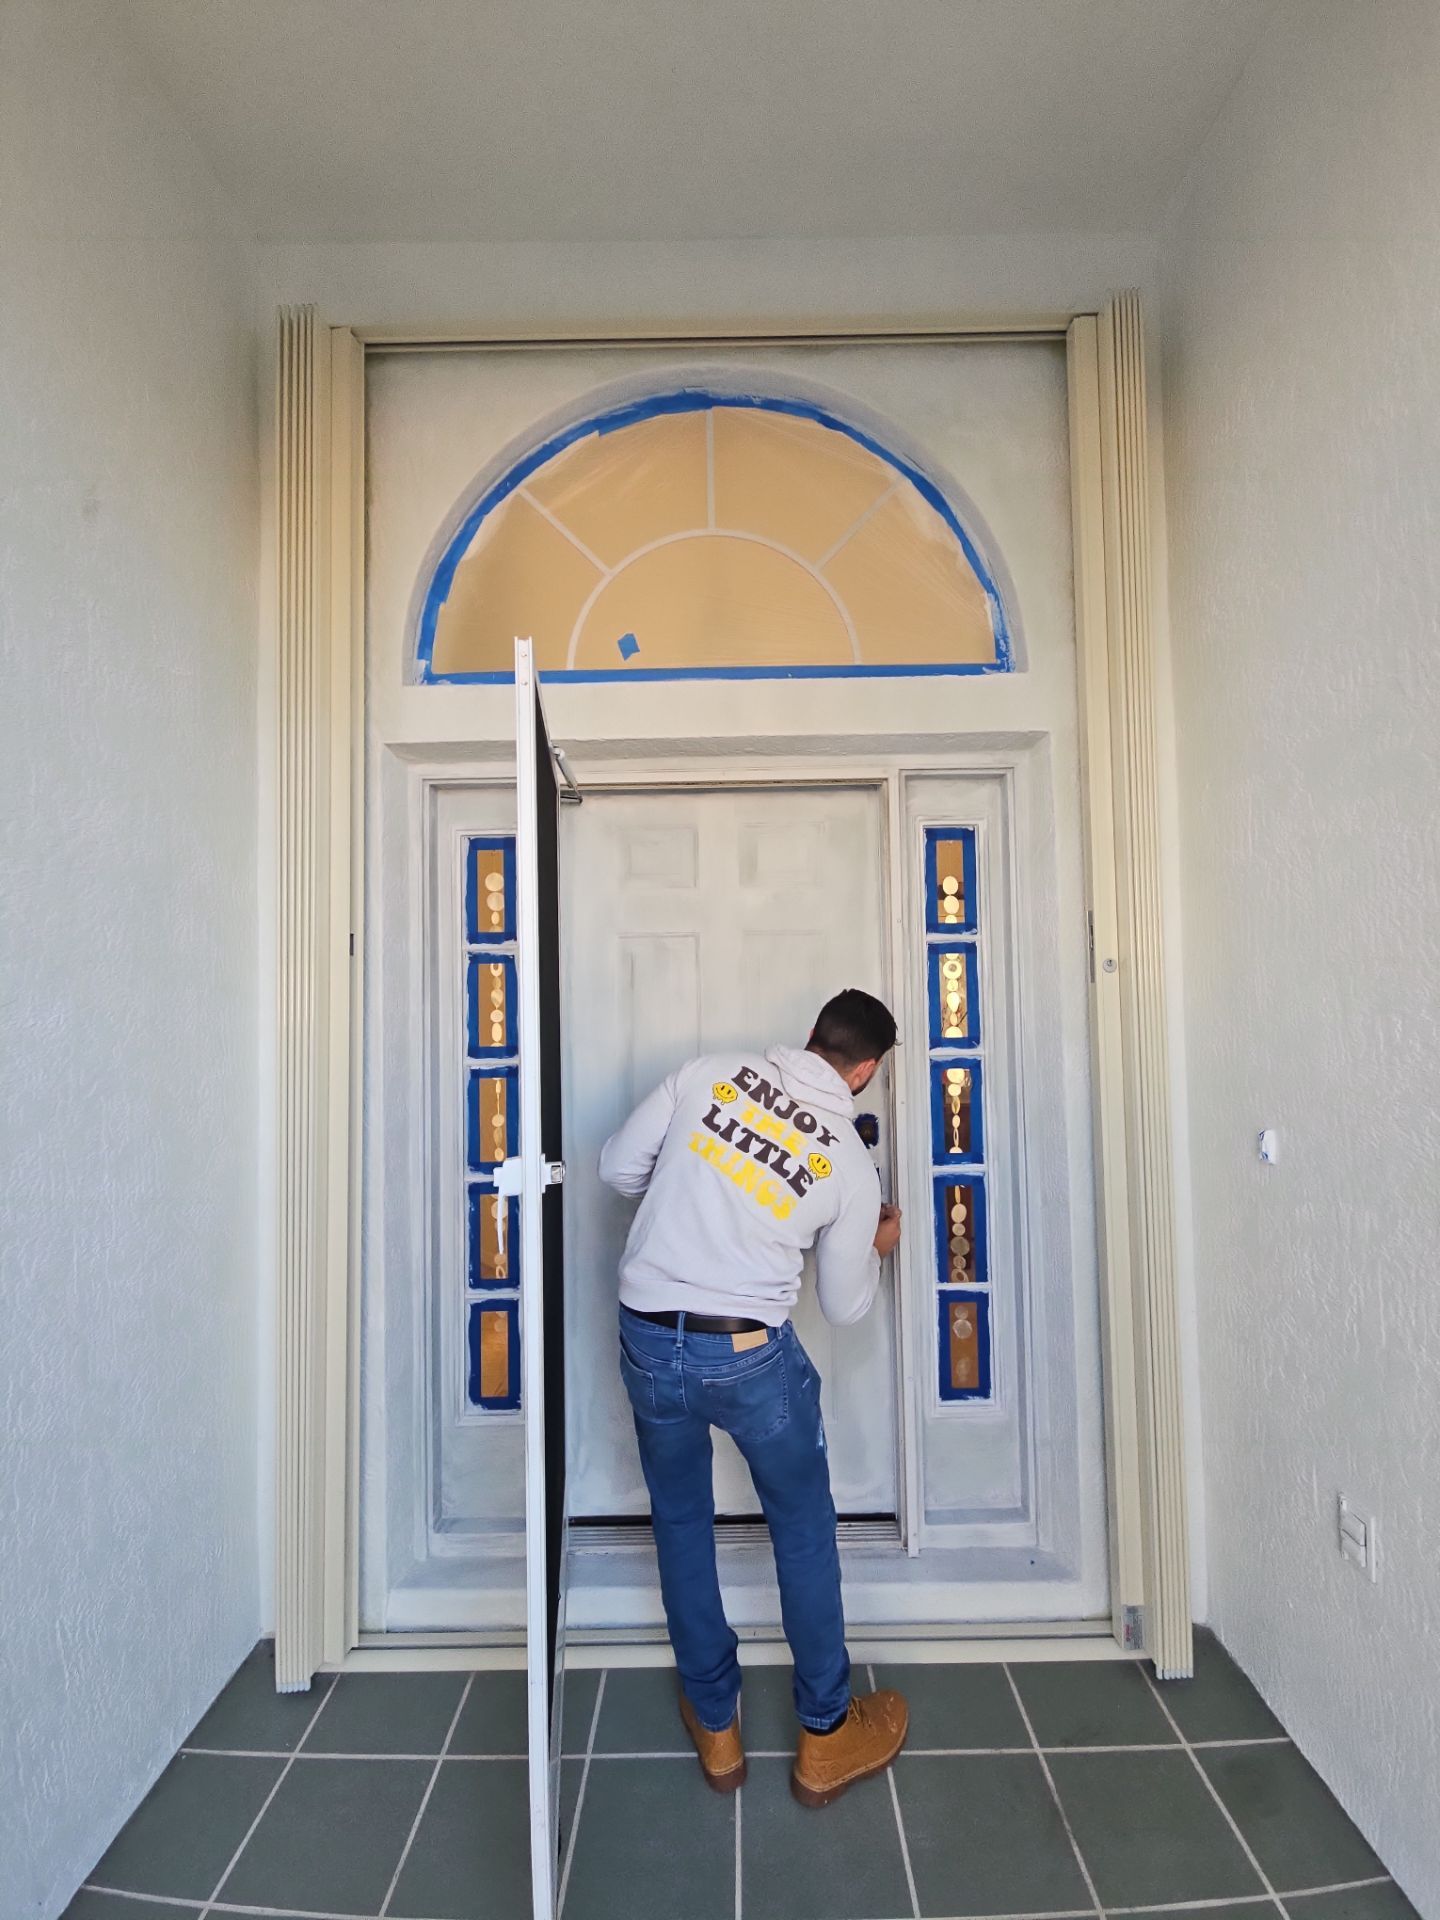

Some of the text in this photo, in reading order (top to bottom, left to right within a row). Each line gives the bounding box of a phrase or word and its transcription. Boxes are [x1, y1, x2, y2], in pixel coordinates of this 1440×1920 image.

[731, 1066, 840, 1147] ENJOY
[740, 1101, 807, 1157] THE
[687, 1131, 797, 1221] THINGS
[702, 1104, 814, 1198] LITTLE
